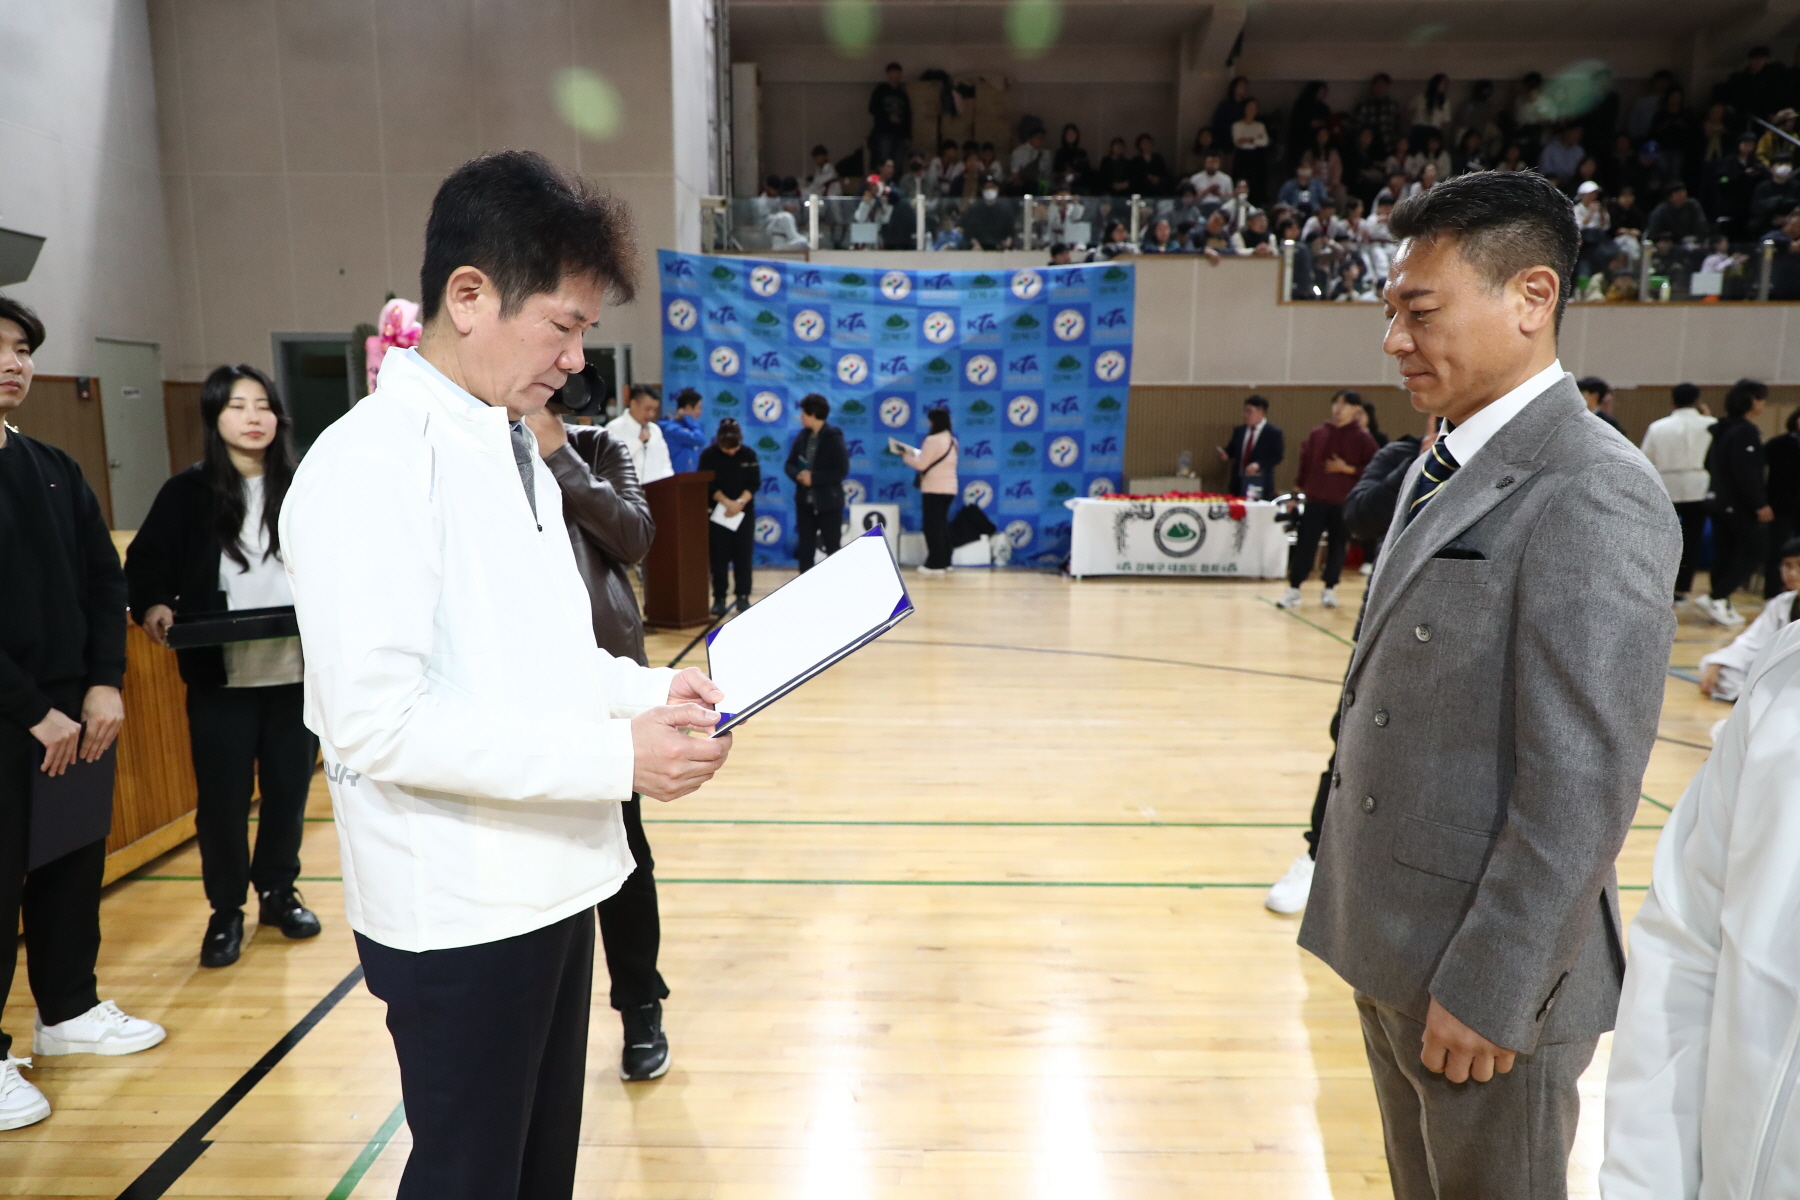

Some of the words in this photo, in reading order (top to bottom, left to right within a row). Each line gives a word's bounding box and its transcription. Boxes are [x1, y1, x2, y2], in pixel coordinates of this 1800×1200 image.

[664, 259, 694, 277] KTA
[1055, 268, 1085, 286] KTA
[794, 270, 824, 287] KTA
[924, 273, 954, 289] KTA
[709, 306, 737, 324] KTA
[837, 312, 866, 331] KTA
[967, 313, 997, 333] KTA
[1097, 308, 1126, 328] KTA
[752, 351, 781, 370] KTA
[880, 355, 909, 374] KTA
[1009, 354, 1038, 373] KTA
[1050, 396, 1079, 415] KTA
[847, 440, 865, 457] TA
[964, 440, 993, 458] KTA
[1091, 436, 1117, 455] KTA
[879, 482, 906, 500] KTA
[1005, 480, 1034, 499] KTA
[323, 759, 361, 787] UR
